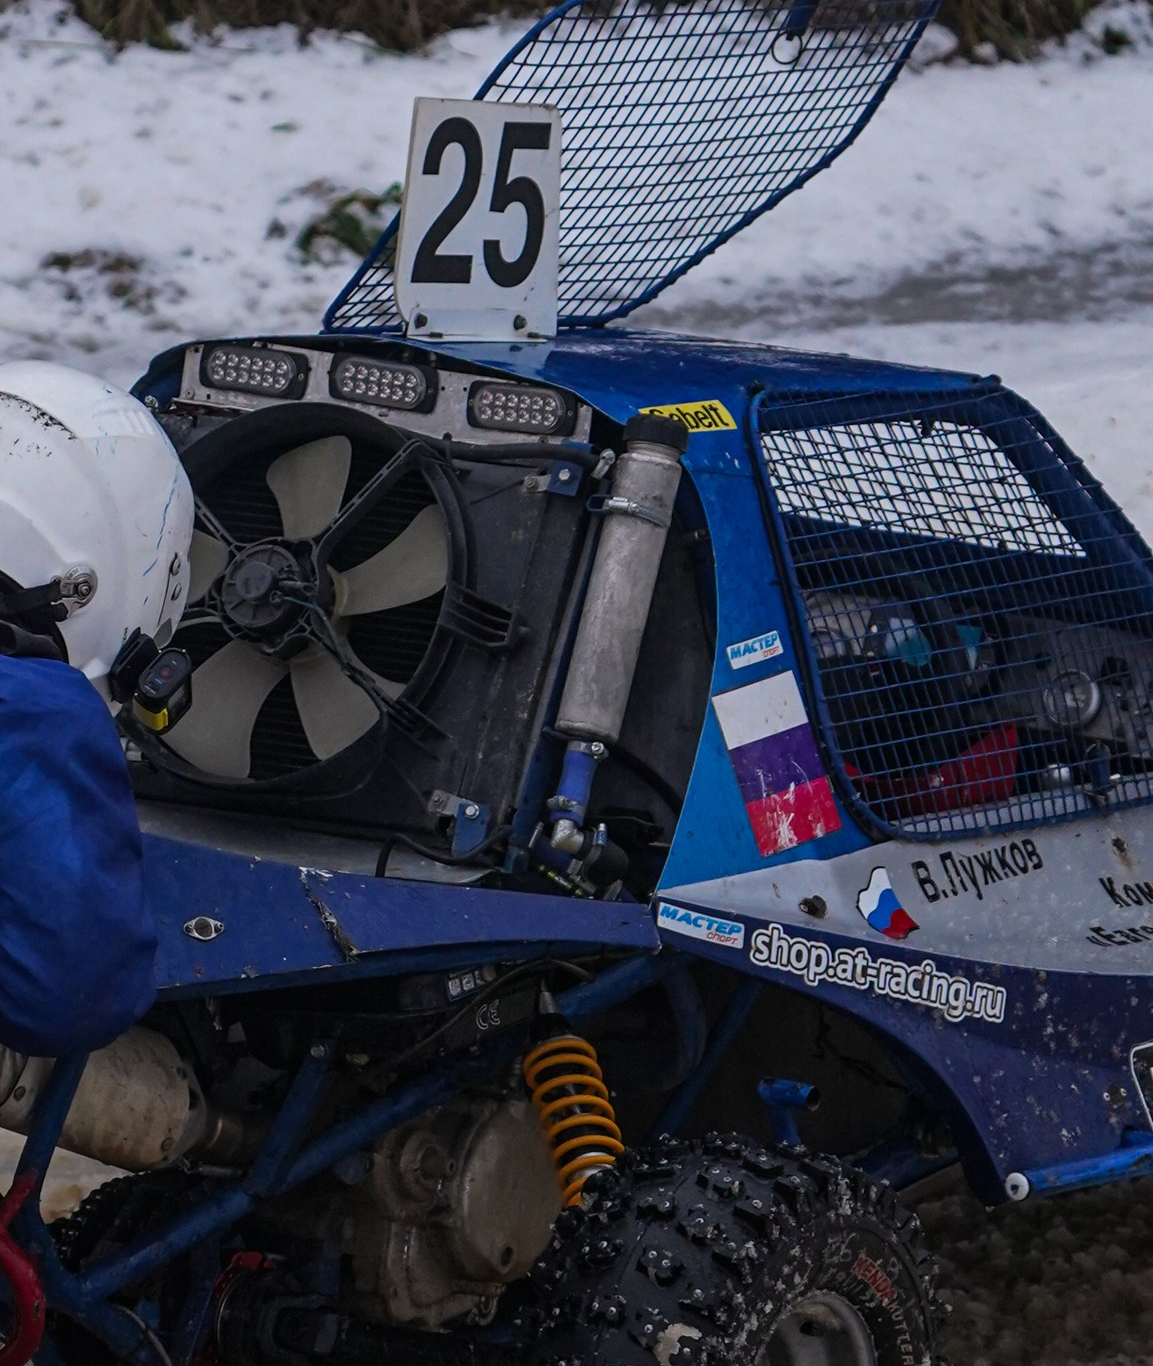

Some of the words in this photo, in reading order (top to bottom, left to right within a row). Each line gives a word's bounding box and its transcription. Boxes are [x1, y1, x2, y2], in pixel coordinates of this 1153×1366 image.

[410, 116, 552, 288] 25
[730, 633, 778, 659] МАСТЕР
[660, 905, 742, 935] МАСТЕР
[752, 925, 1005, 1022] shop.at-racing.ru
